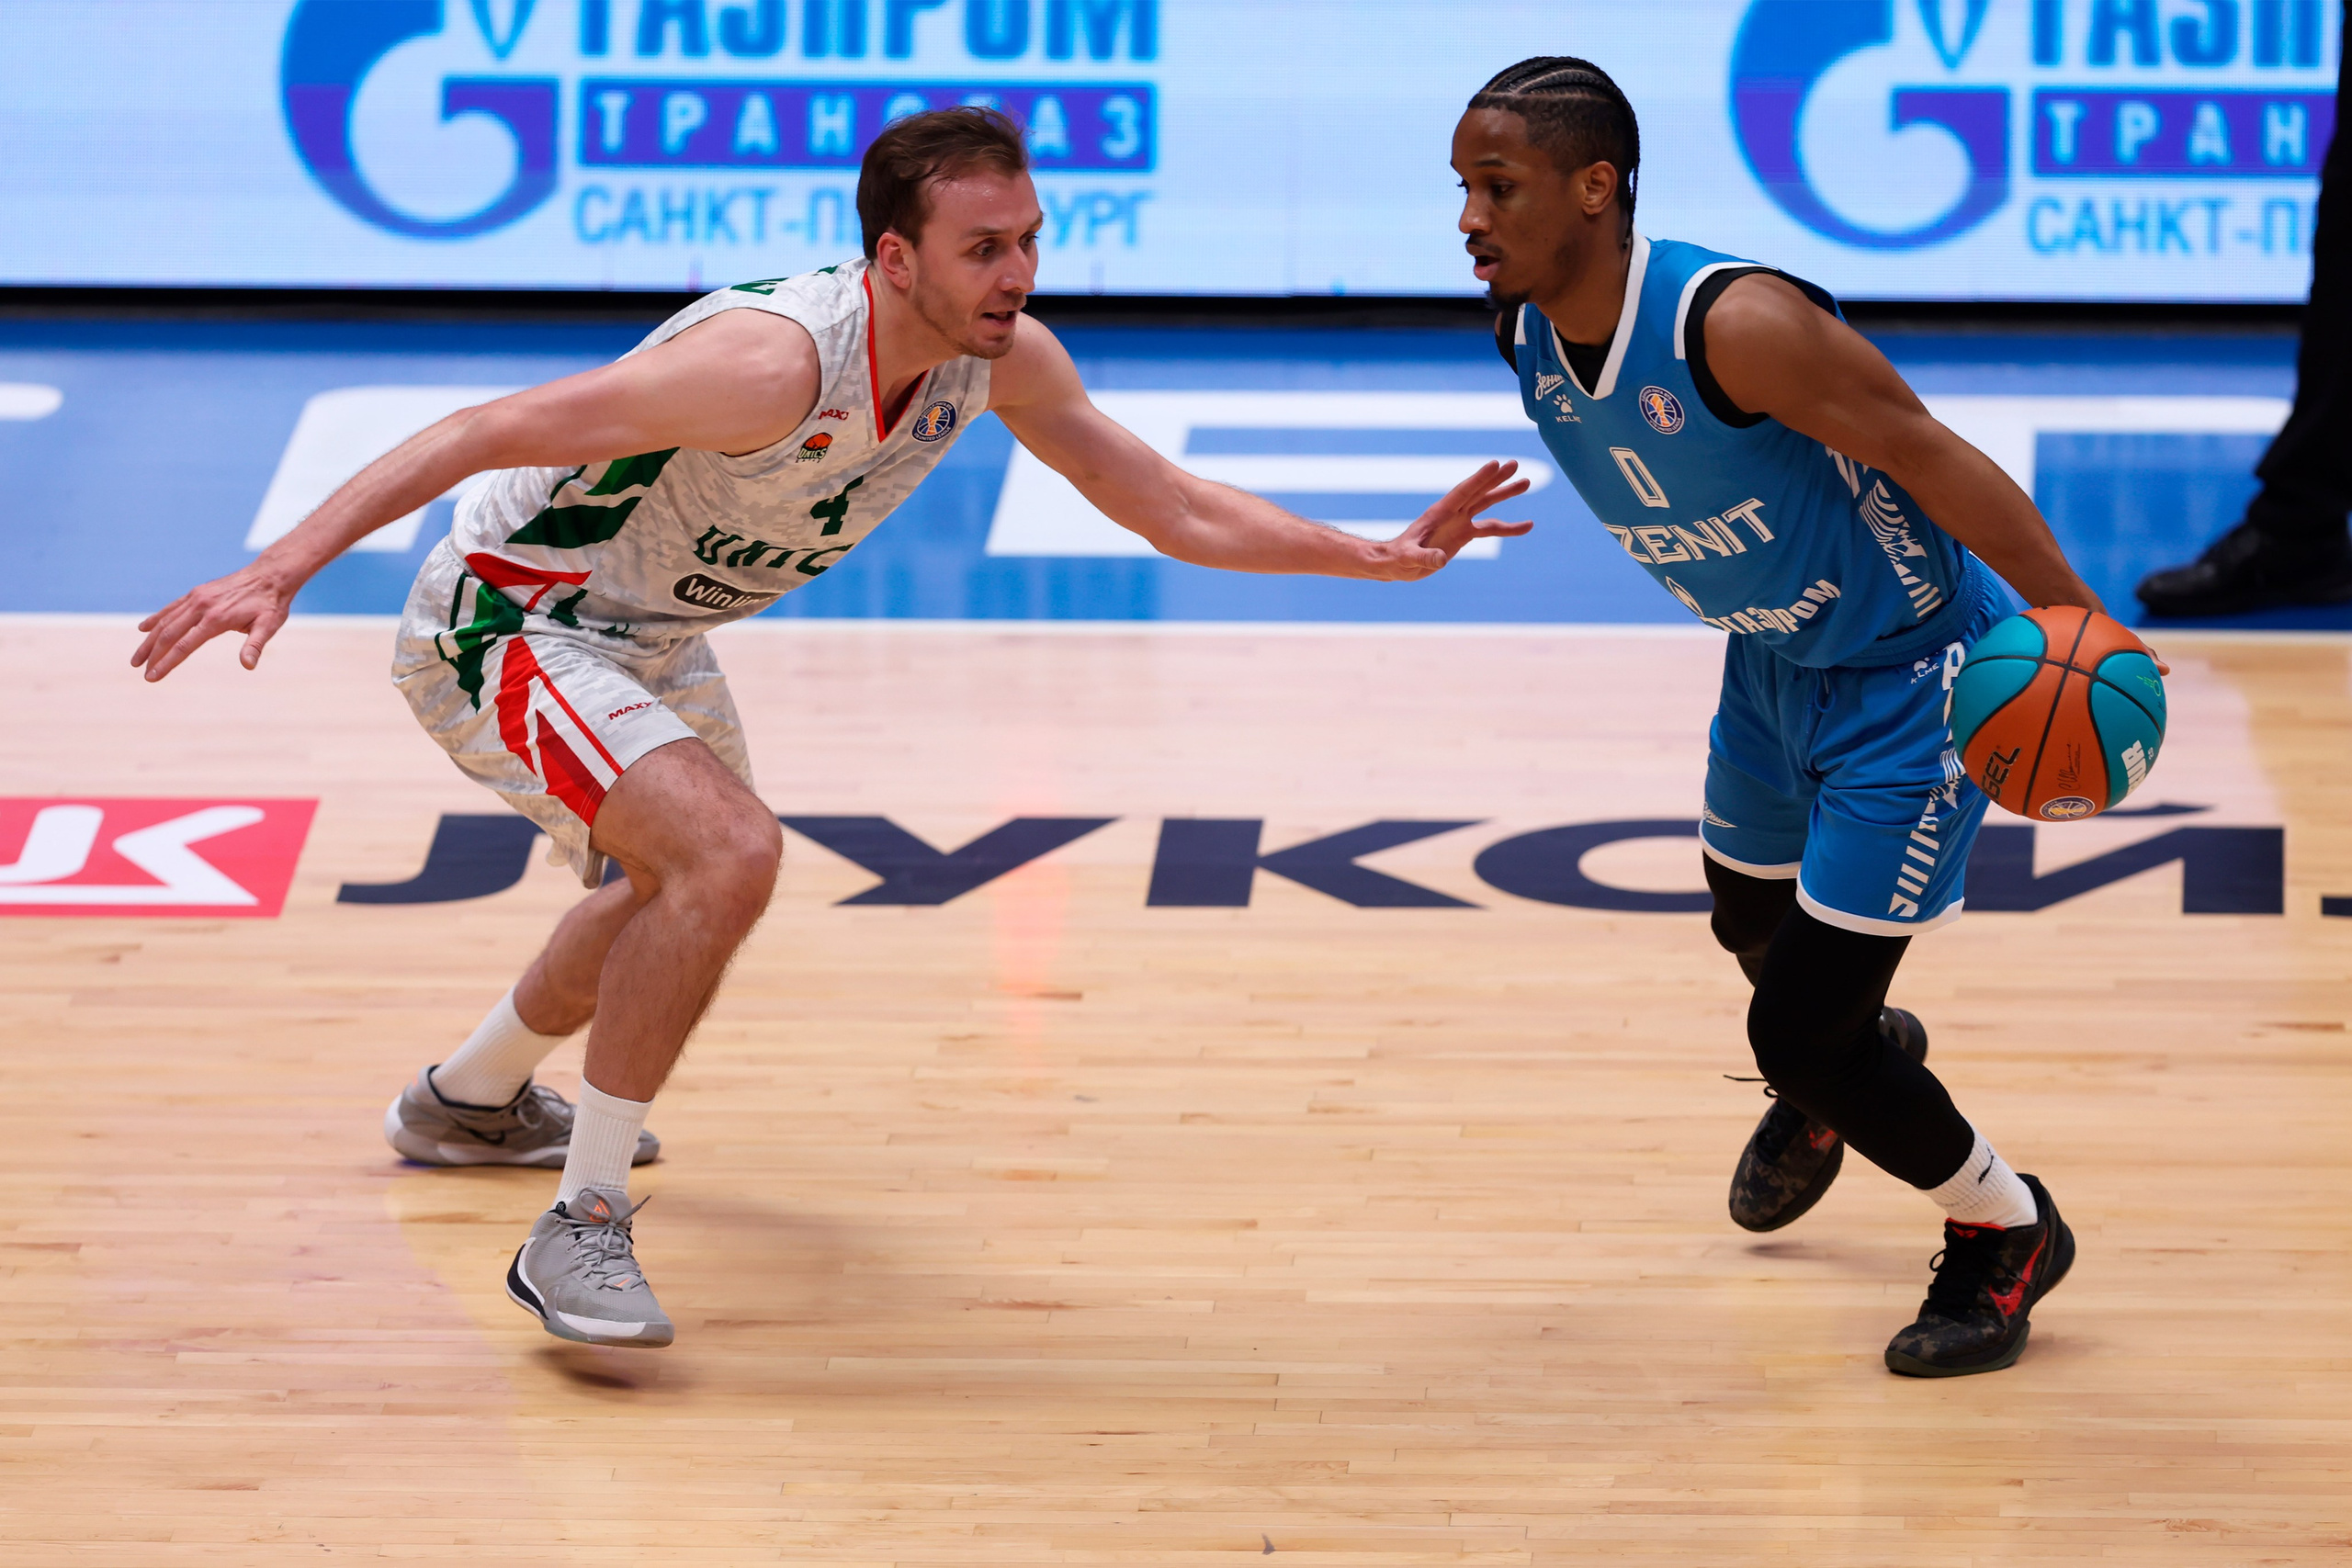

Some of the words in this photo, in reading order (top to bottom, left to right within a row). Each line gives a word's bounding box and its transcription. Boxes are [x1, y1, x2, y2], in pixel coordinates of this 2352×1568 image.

[594, 89, 1142, 160] ТРАНАЗ
[571, 186, 1150, 246] САНКТ-ПУРГ
[809, 475, 864, 536] 4
[1609, 446, 1670, 509] 0
[1601, 497, 1776, 565] ZENIT
[1910, 662, 1940, 685] KLME
[1981, 747, 2022, 807] GEL
[336, 803, 2352, 918] ЛУКОЙ
